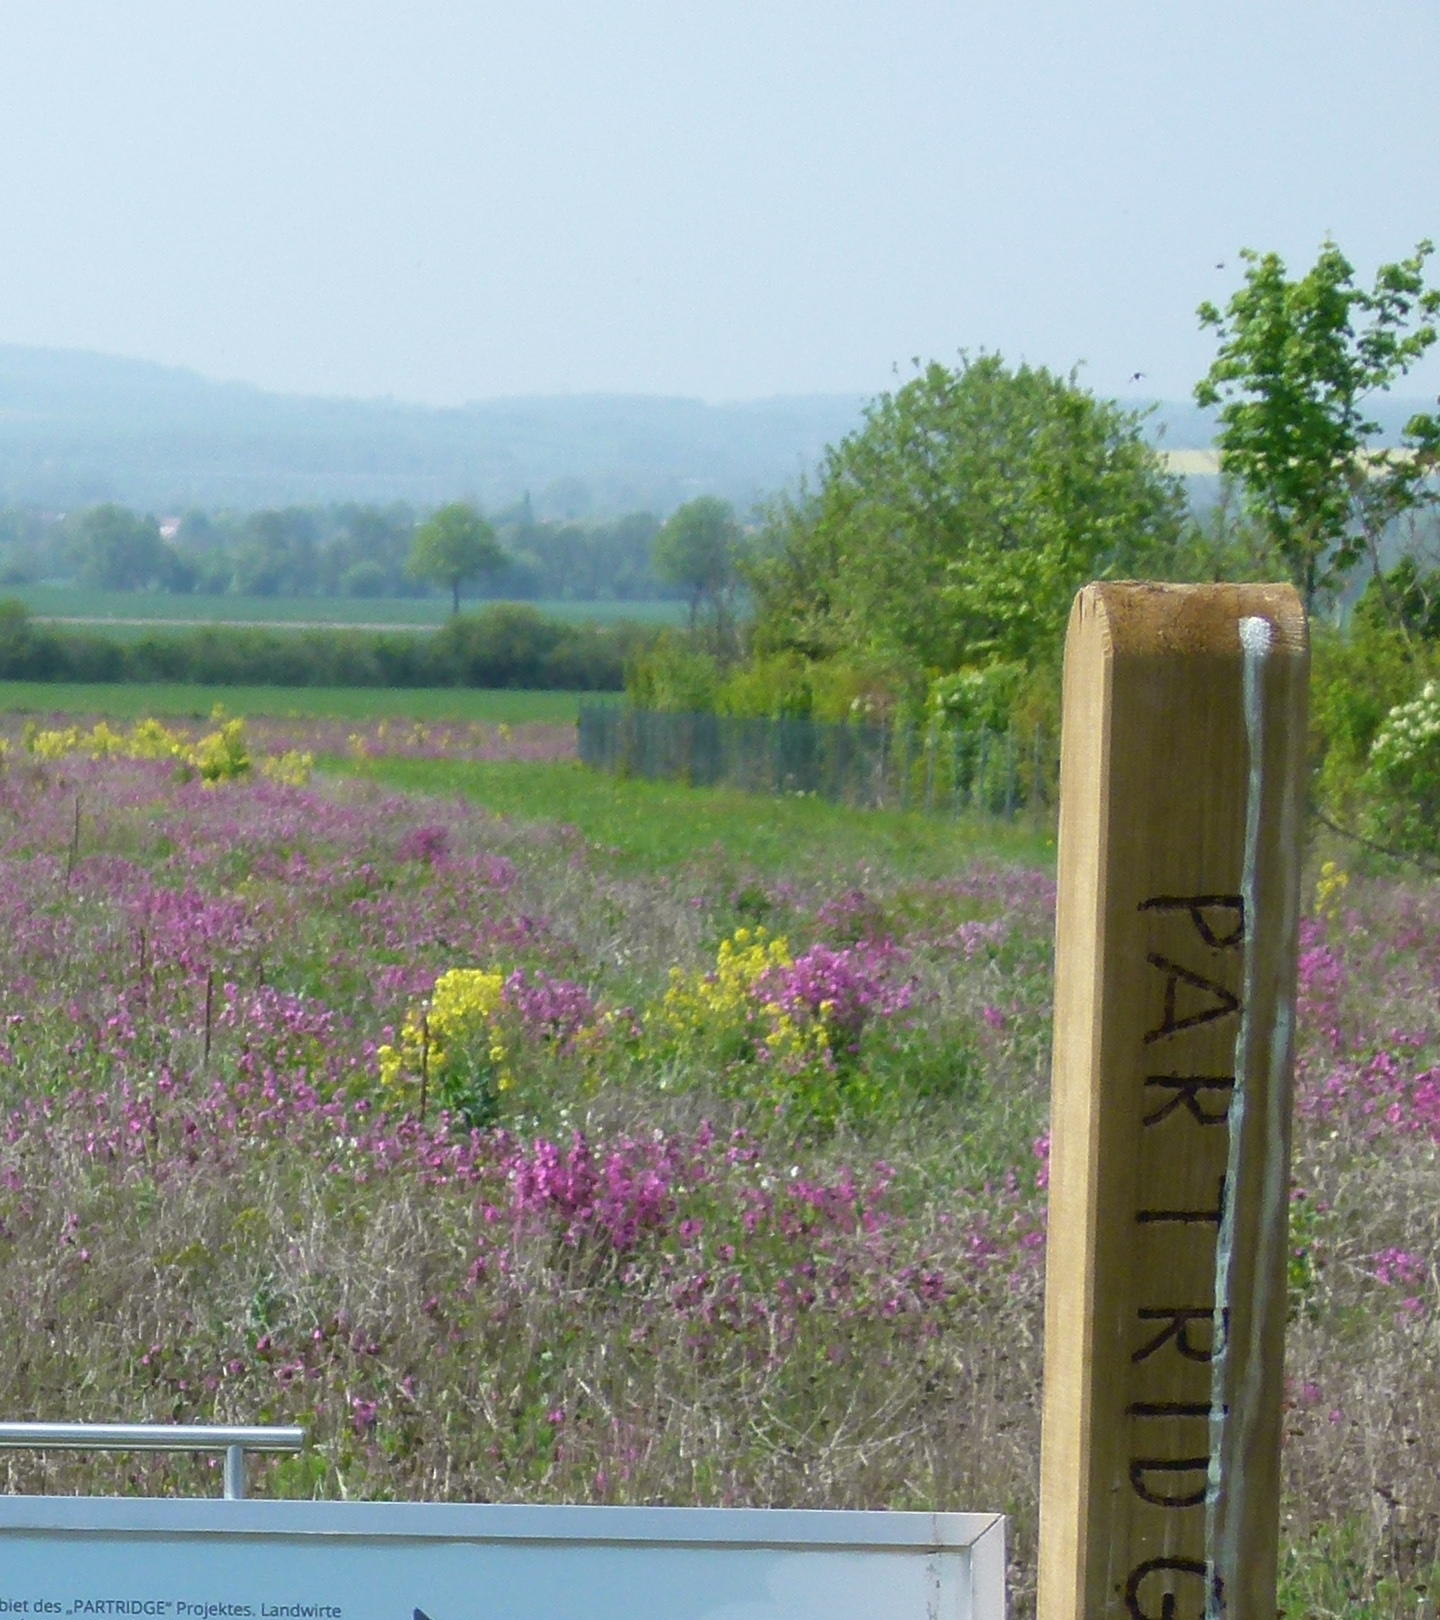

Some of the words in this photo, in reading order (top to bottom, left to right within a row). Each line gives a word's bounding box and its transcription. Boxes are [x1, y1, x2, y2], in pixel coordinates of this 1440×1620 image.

[33, 1598, 61, 1613] des
[176, 1600, 255, 1620] Projektes.
[261, 1602, 341, 1618] Landwirte
